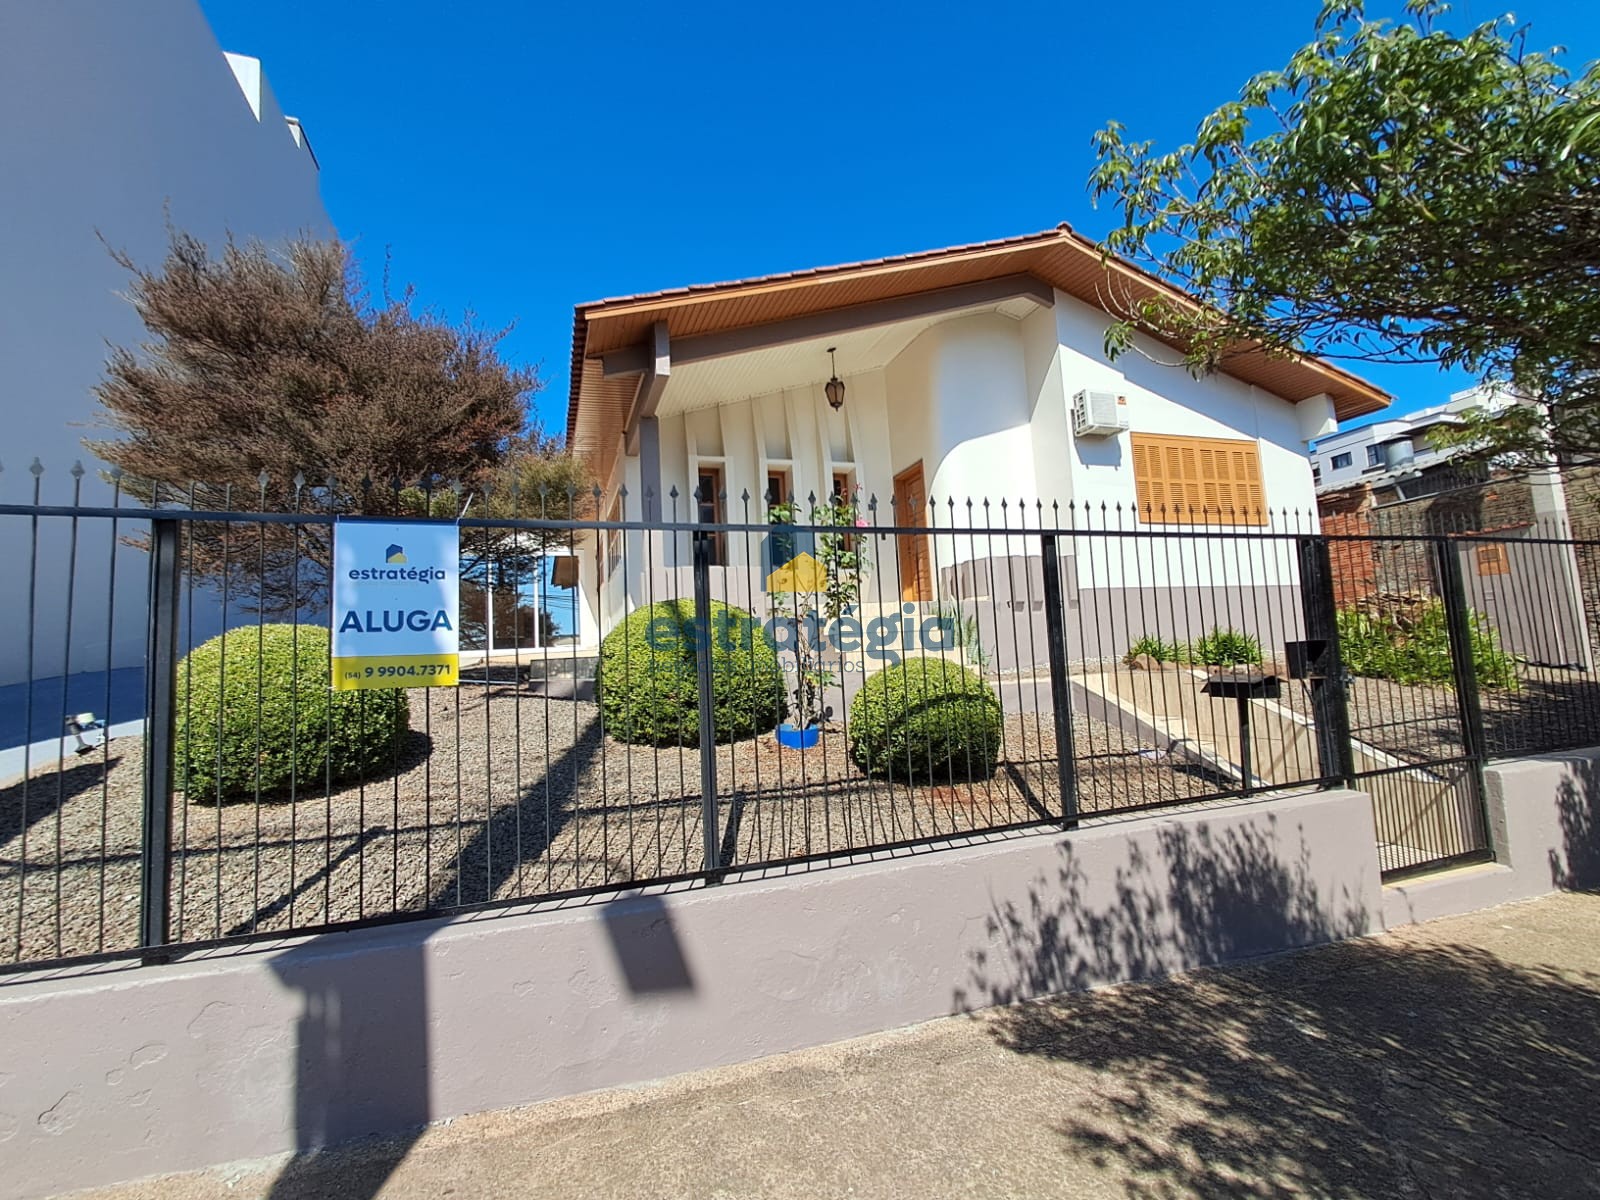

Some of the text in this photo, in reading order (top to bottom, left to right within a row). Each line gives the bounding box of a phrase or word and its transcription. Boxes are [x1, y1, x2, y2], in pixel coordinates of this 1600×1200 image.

[348, 566, 446, 584] estratégia
[339, 610, 453, 633] ALUGA
[344, 664, 451, 680] (54) 9 9904.7371
